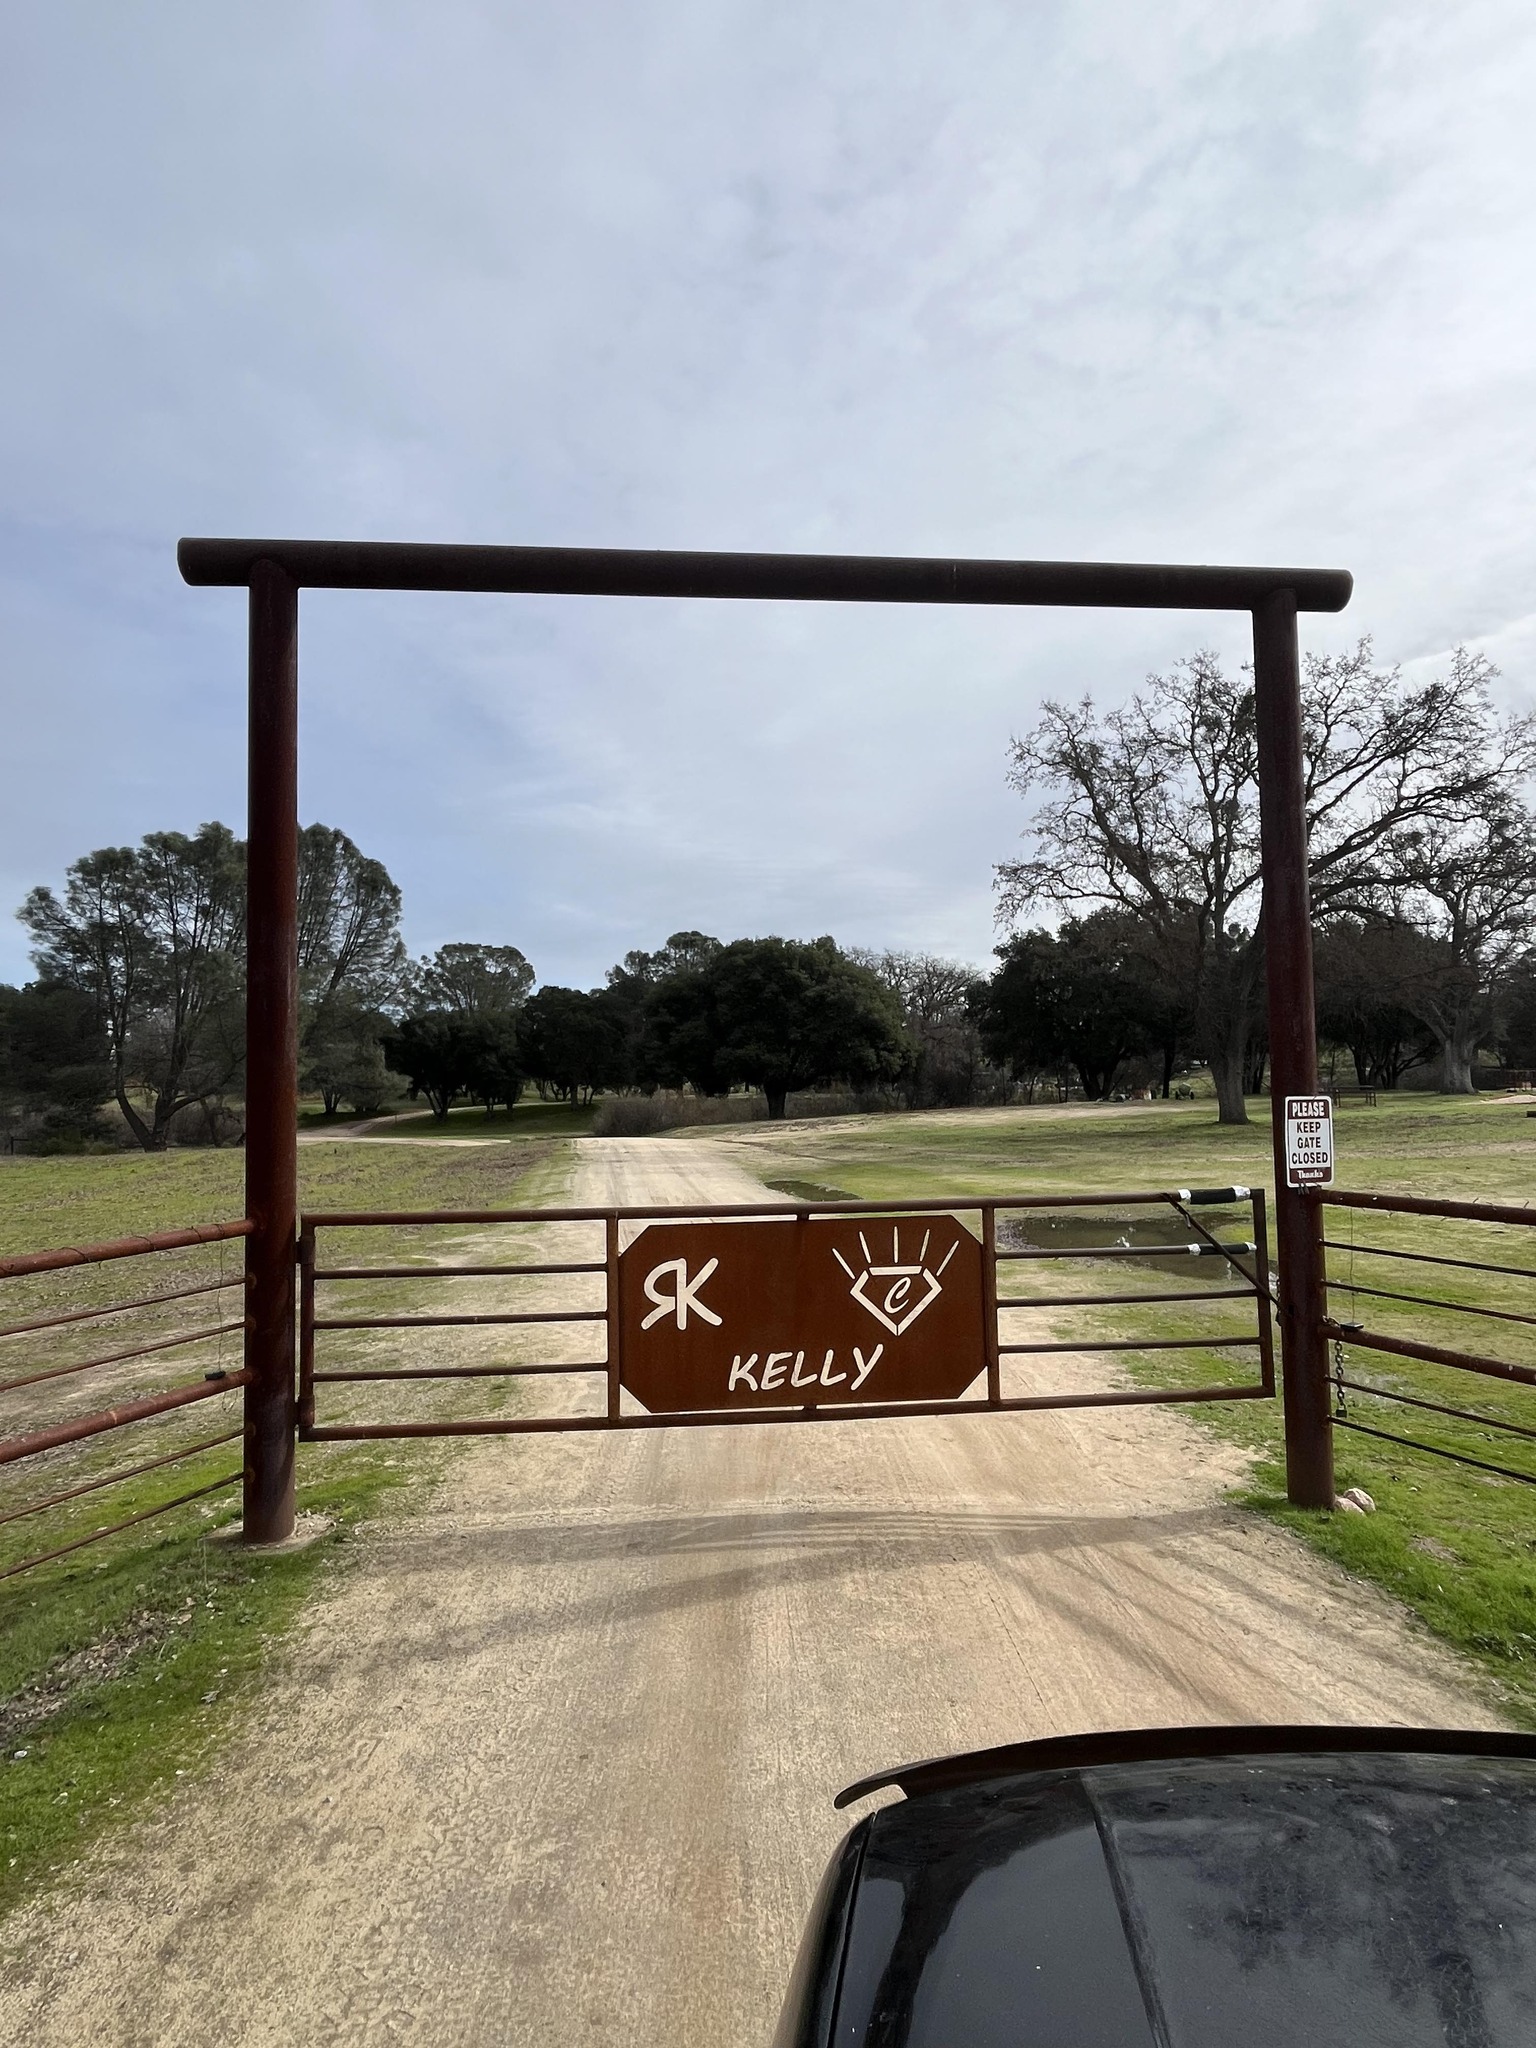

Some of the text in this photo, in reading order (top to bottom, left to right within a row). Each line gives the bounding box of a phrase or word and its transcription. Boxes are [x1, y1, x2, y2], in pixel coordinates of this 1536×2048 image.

[1292, 1101, 1325, 1117] PLEASE
[1296, 1121, 1321, 1133] KEEP
[1297, 1137, 1321, 1149] GATE
[1291, 1152, 1328, 1164] CLOSED
[728, 1343, 884, 1391] KELLY
